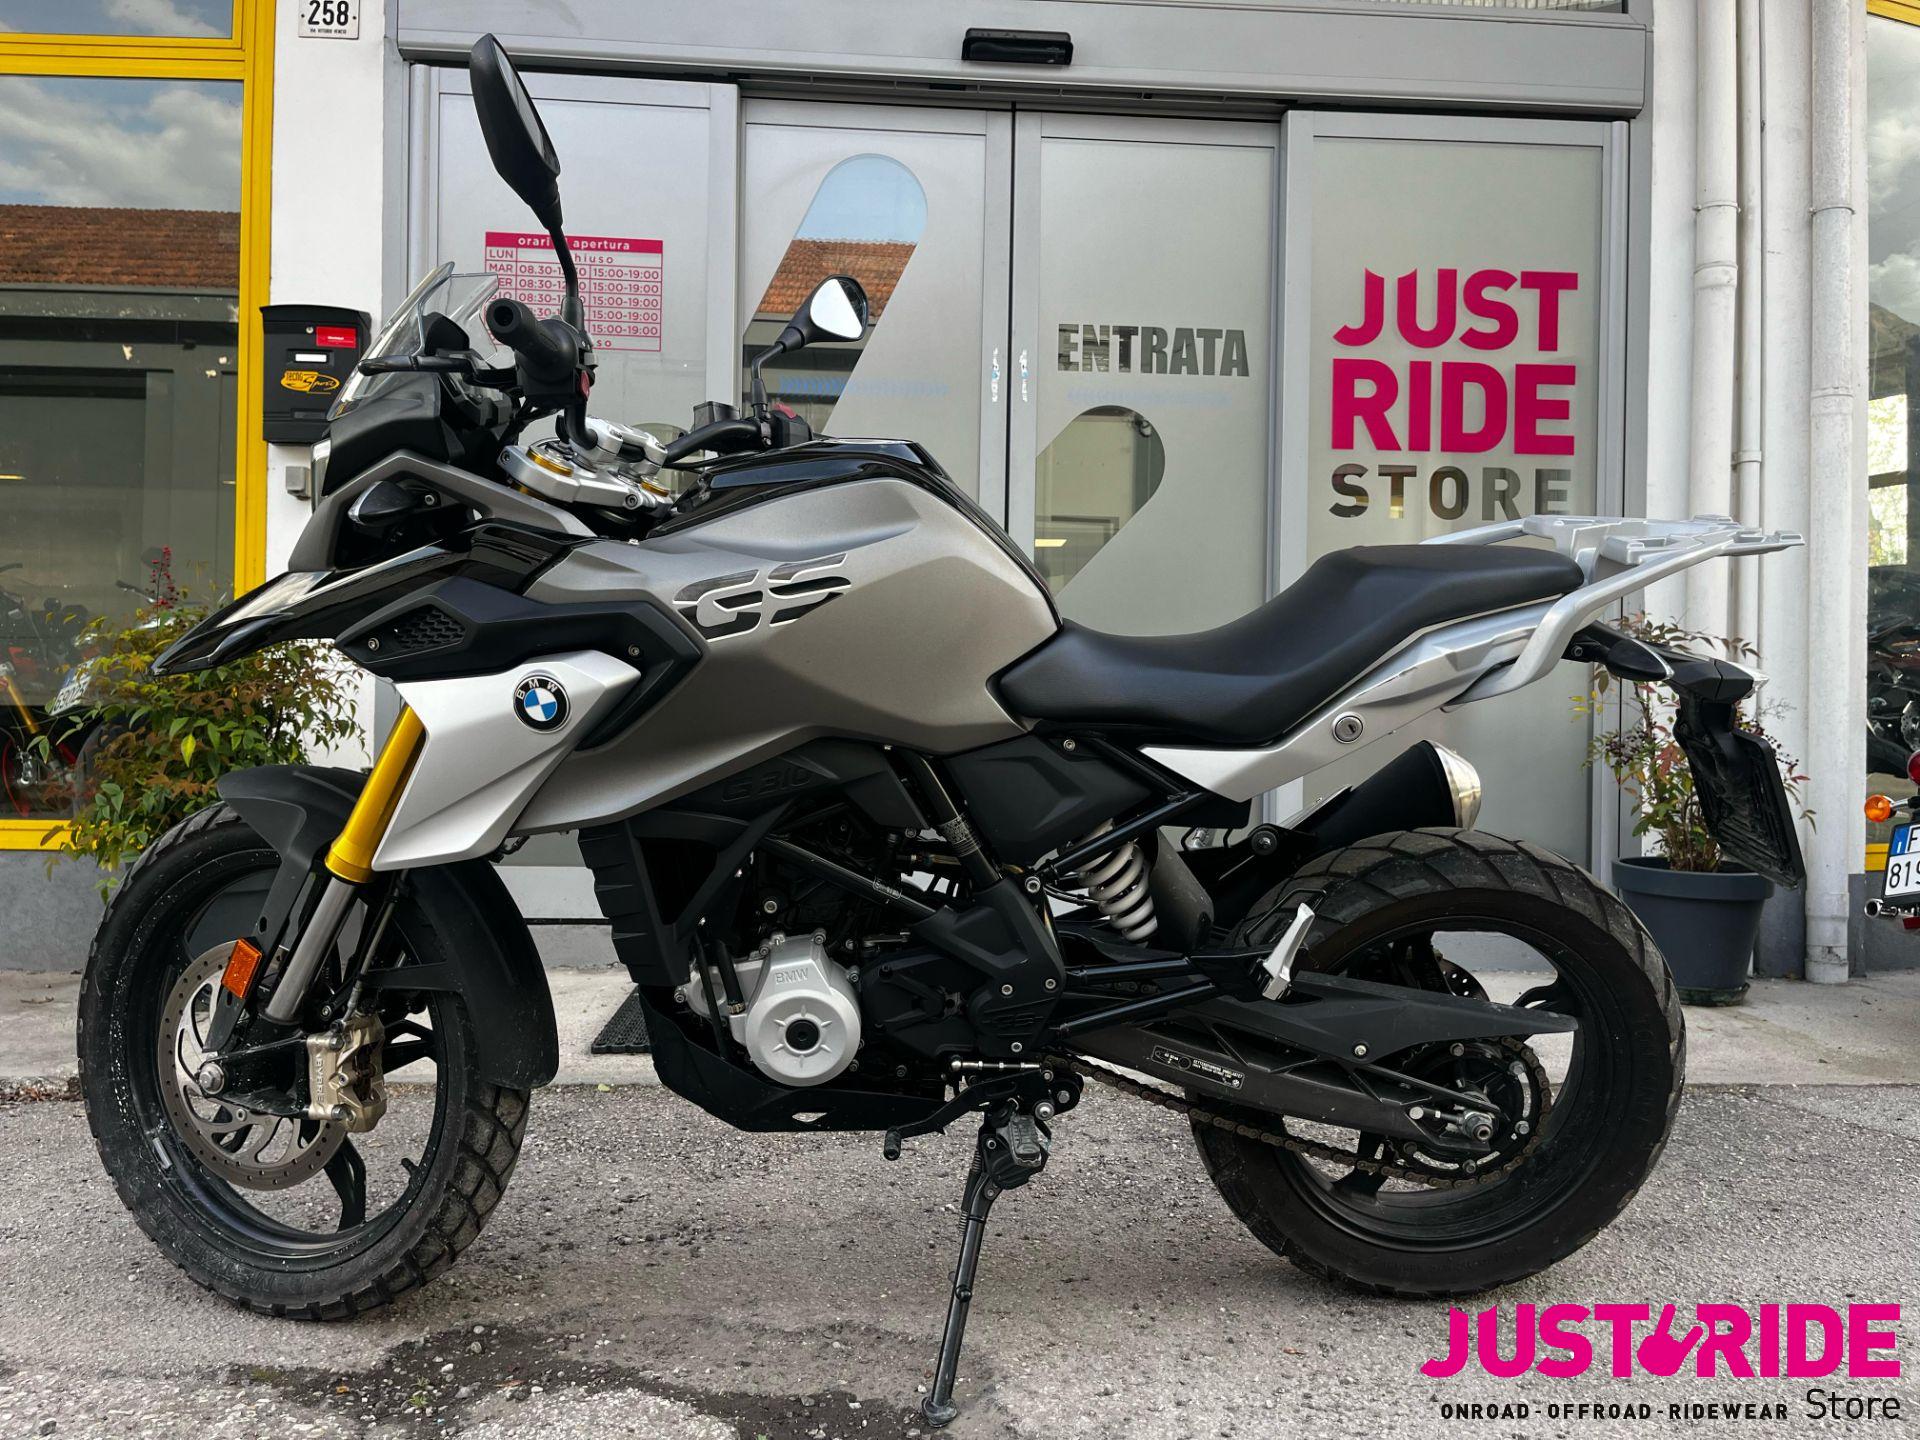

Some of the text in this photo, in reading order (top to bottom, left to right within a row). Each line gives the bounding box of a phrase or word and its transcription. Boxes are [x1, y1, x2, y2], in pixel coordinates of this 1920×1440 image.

[308, 0, 349, 26] 258
[518, 237, 630, 250] orari apertura
[489, 249, 614, 264] LUN hiuso
[489, 263, 513, 272] MAR
[593, 268, 659, 279] 15:00-19:00
[593, 282, 659, 293] 15:00-19:00
[593, 296, 659, 307] 15:00-19:00
[593, 310, 659, 321] 15:00-19:00
[1332, 268, 1579, 352] JUST
[592, 324, 658, 335] 15:00-19:00
[1057, 323, 1250, 377] ENTRATA
[1331, 358, 1576, 456] RIDE
[1327, 462, 1572, 520] STORE
[516, 678, 558, 700] BMW
[774, 967, 809, 984] BMW
